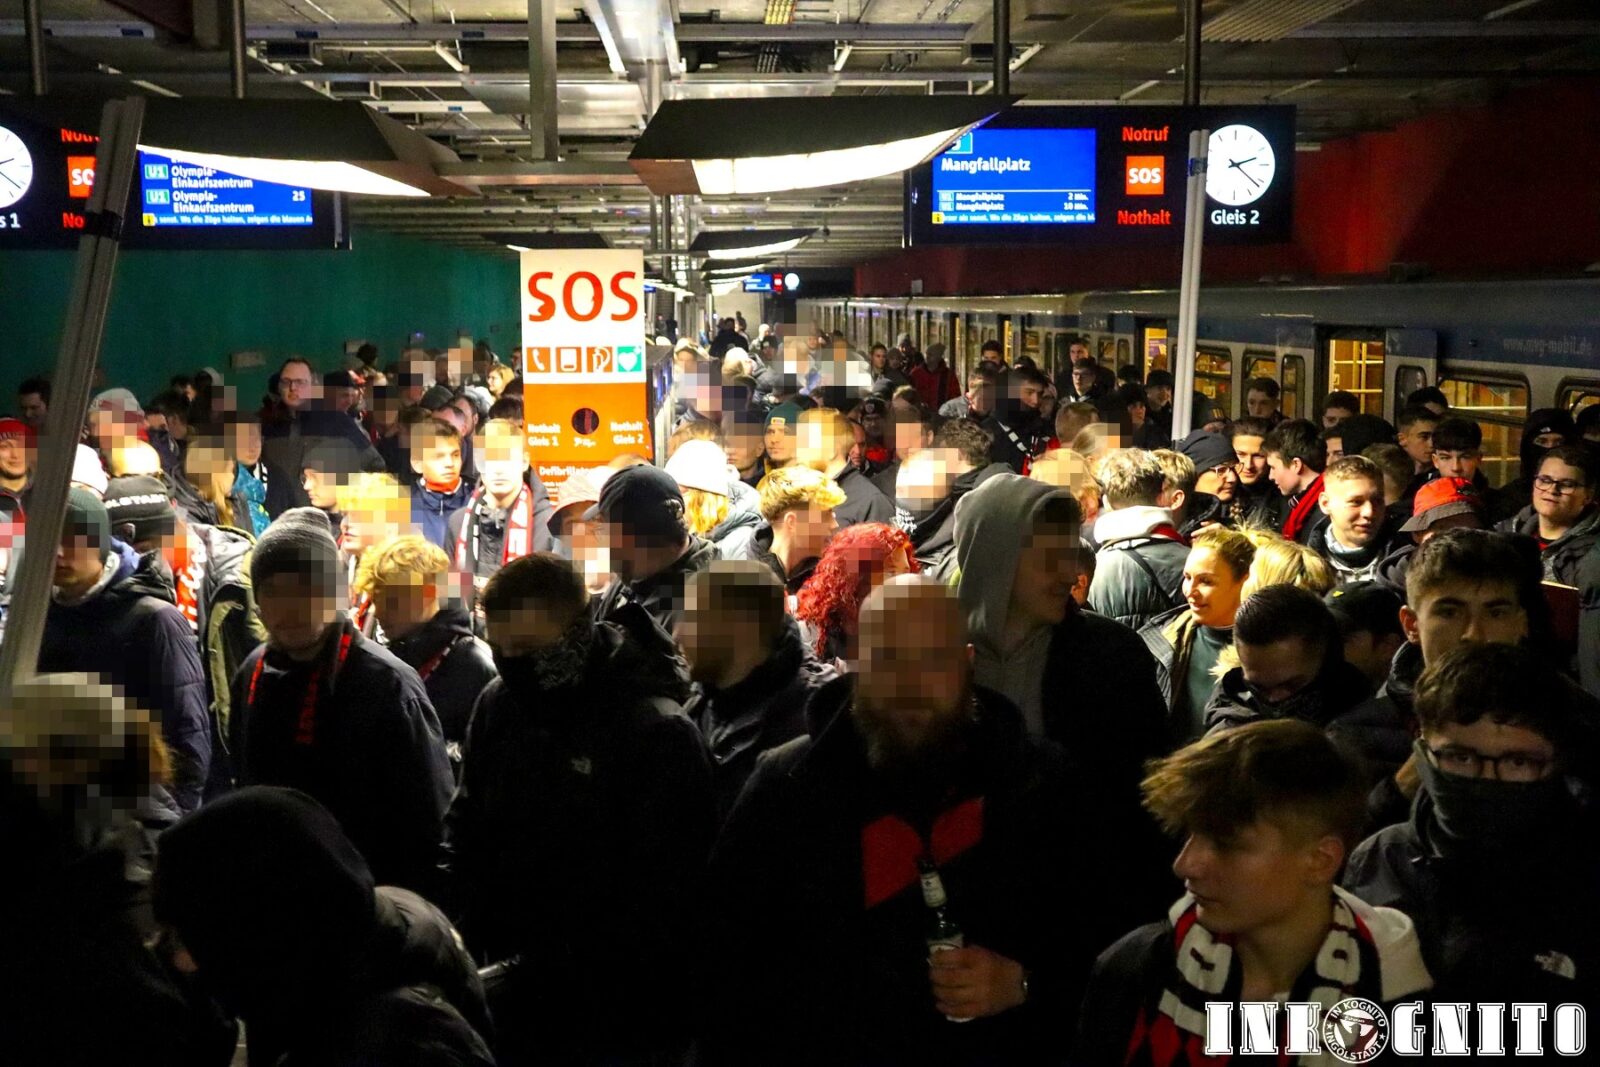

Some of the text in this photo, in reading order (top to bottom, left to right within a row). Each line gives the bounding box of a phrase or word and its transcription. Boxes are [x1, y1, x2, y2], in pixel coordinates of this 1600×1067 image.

[1122, 126, 1169, 142] Notruf
[148, 165, 217, 179] U1 Olympia-
[941, 157, 1031, 174] Mangfallplatz
[71, 168, 95, 186] SO
[172, 178, 253, 188] Einkaufszentrum
[1128, 167, 1162, 184] SOS
[150, 190, 167, 204] U1
[172, 190, 218, 203] Olympia-
[956, 192, 1005, 202] Mangfallplatz
[173, 202, 254, 213] Einkaufszentrum
[956, 202, 1005, 212] Mangfallplatz
[10, 212, 21, 228] 1
[1117, 210, 1171, 225] Nothalt
[1211, 209, 1260, 225] Gleis 2
[527, 271, 639, 322] SOS
[637, 434, 644, 444] 2
